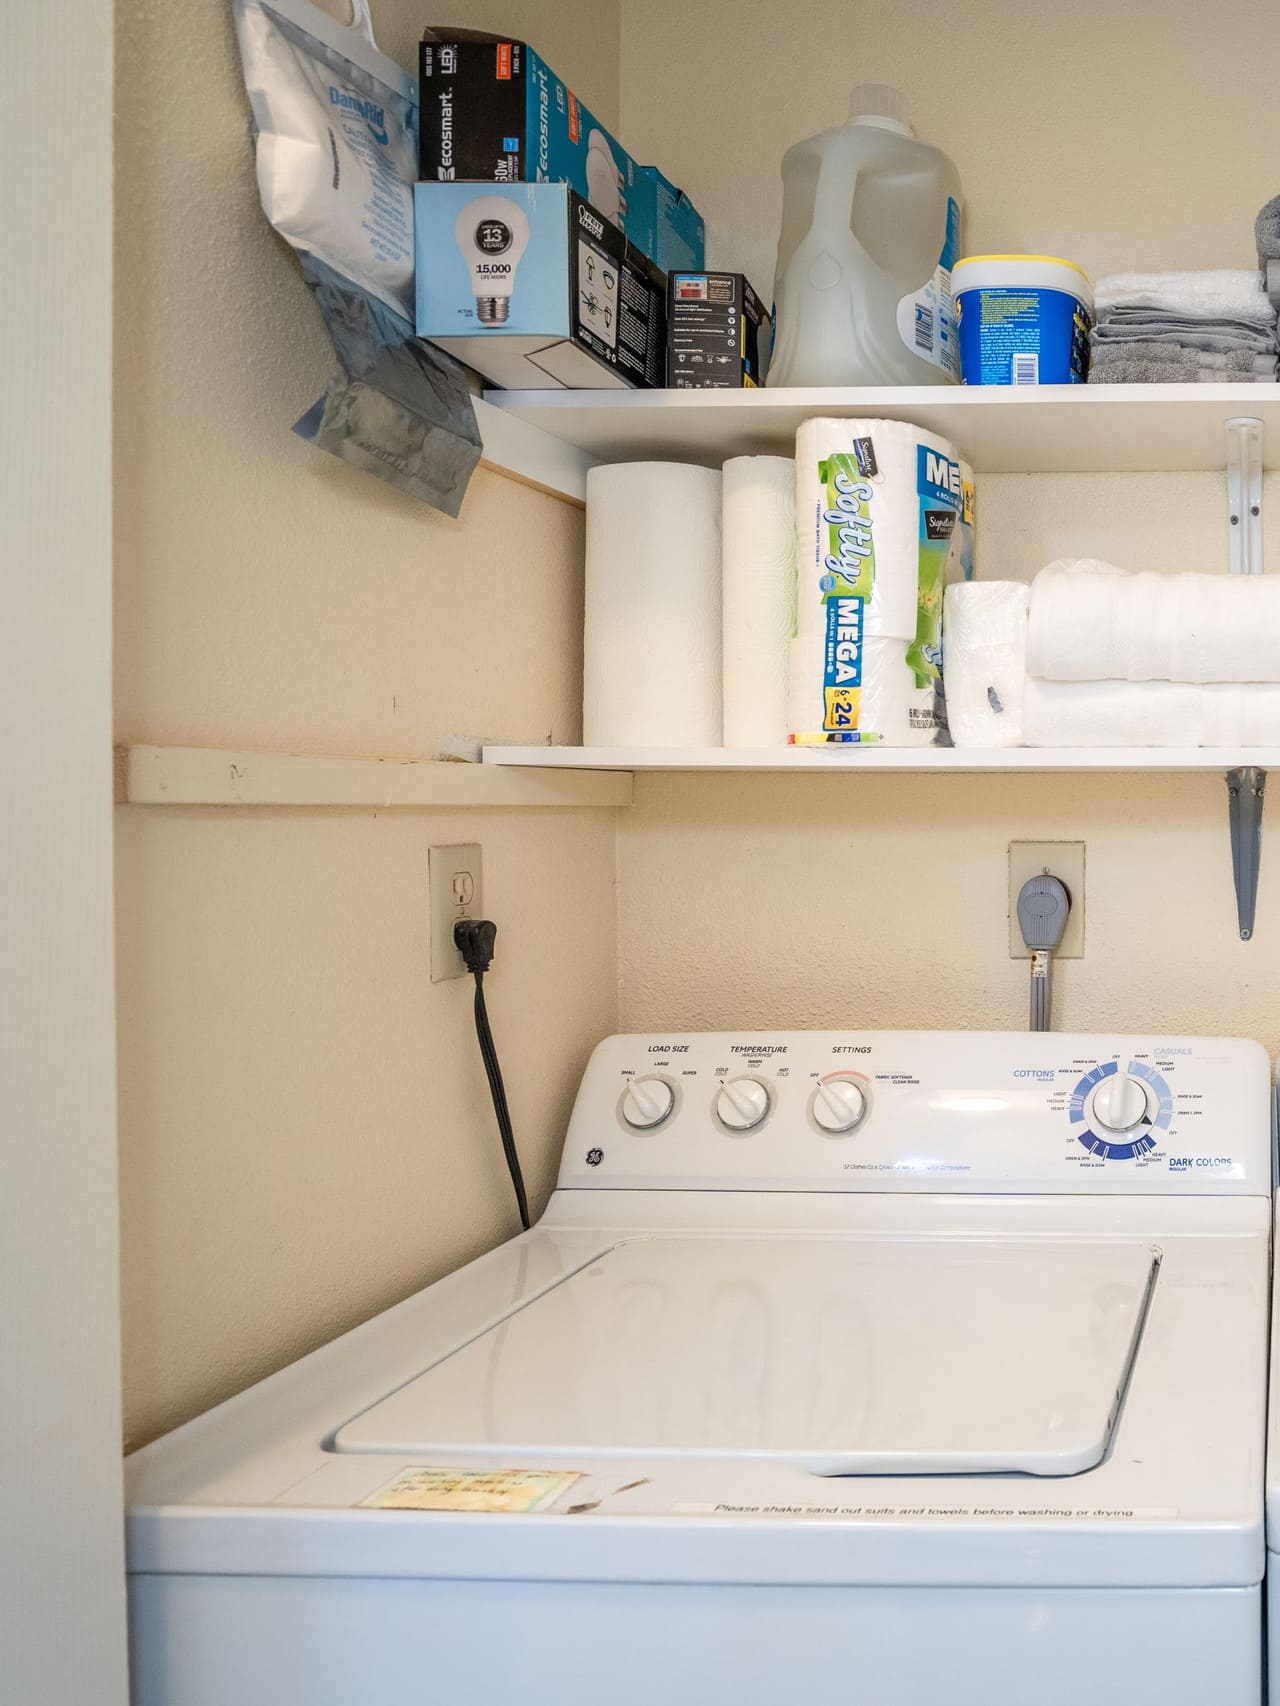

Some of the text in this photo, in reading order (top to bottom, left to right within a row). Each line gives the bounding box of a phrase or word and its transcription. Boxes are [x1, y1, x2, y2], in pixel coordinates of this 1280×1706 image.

[440, 48, 453, 74] LED
[537, 69, 549, 172] ecosmart
[438, 92, 453, 166] ecosmart
[482, 228, 502, 242] 13
[476, 264, 512, 275] 15,000
[823, 472, 874, 584] Softly
[835, 599, 860, 684] MEGA
[835, 702, 852, 726] 24
[832, 1046, 872, 1054] SETTINGS
[1154, 1048, 1192, 1056] CASUALS
[1013, 1070, 1055, 1078] COTTONS
[1169, 1158, 1232, 1168] DARK COLORS
[714, 1504, 760, 1512] Please
[805, 1506, 839, 1514] sand
[927, 1508, 969, 1516] towels
[972, 1508, 1014, 1516] before
[1018, 1508, 1073, 1517] washing
[1092, 1509, 1134, 1518] drying
